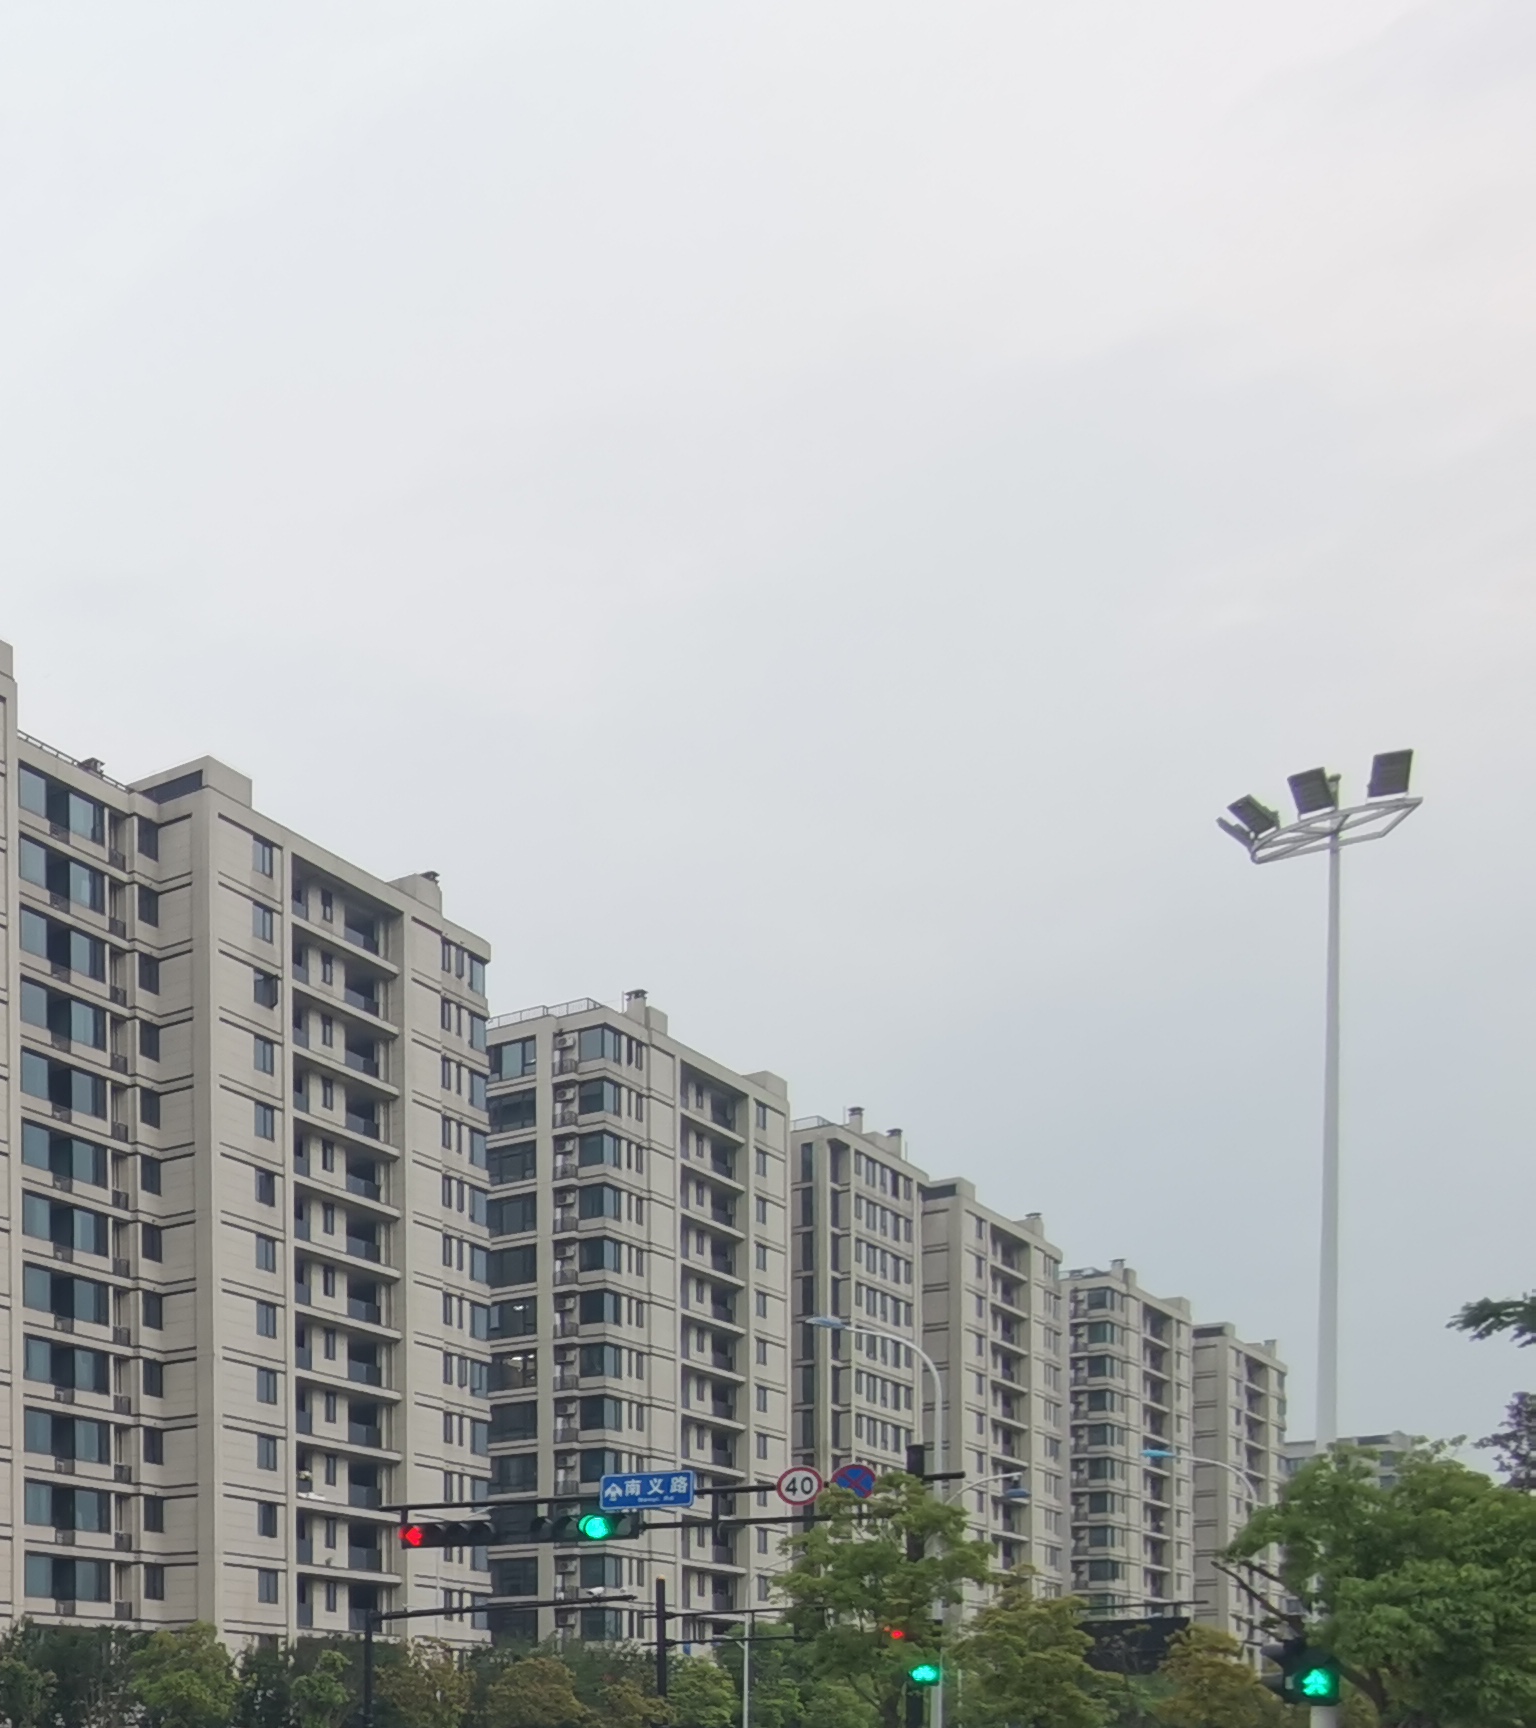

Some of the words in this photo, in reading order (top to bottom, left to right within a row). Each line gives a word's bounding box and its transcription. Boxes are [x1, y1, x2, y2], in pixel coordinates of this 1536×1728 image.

[624, 1475, 688, 1497] 南义路
[785, 1476, 813, 1496] 40
